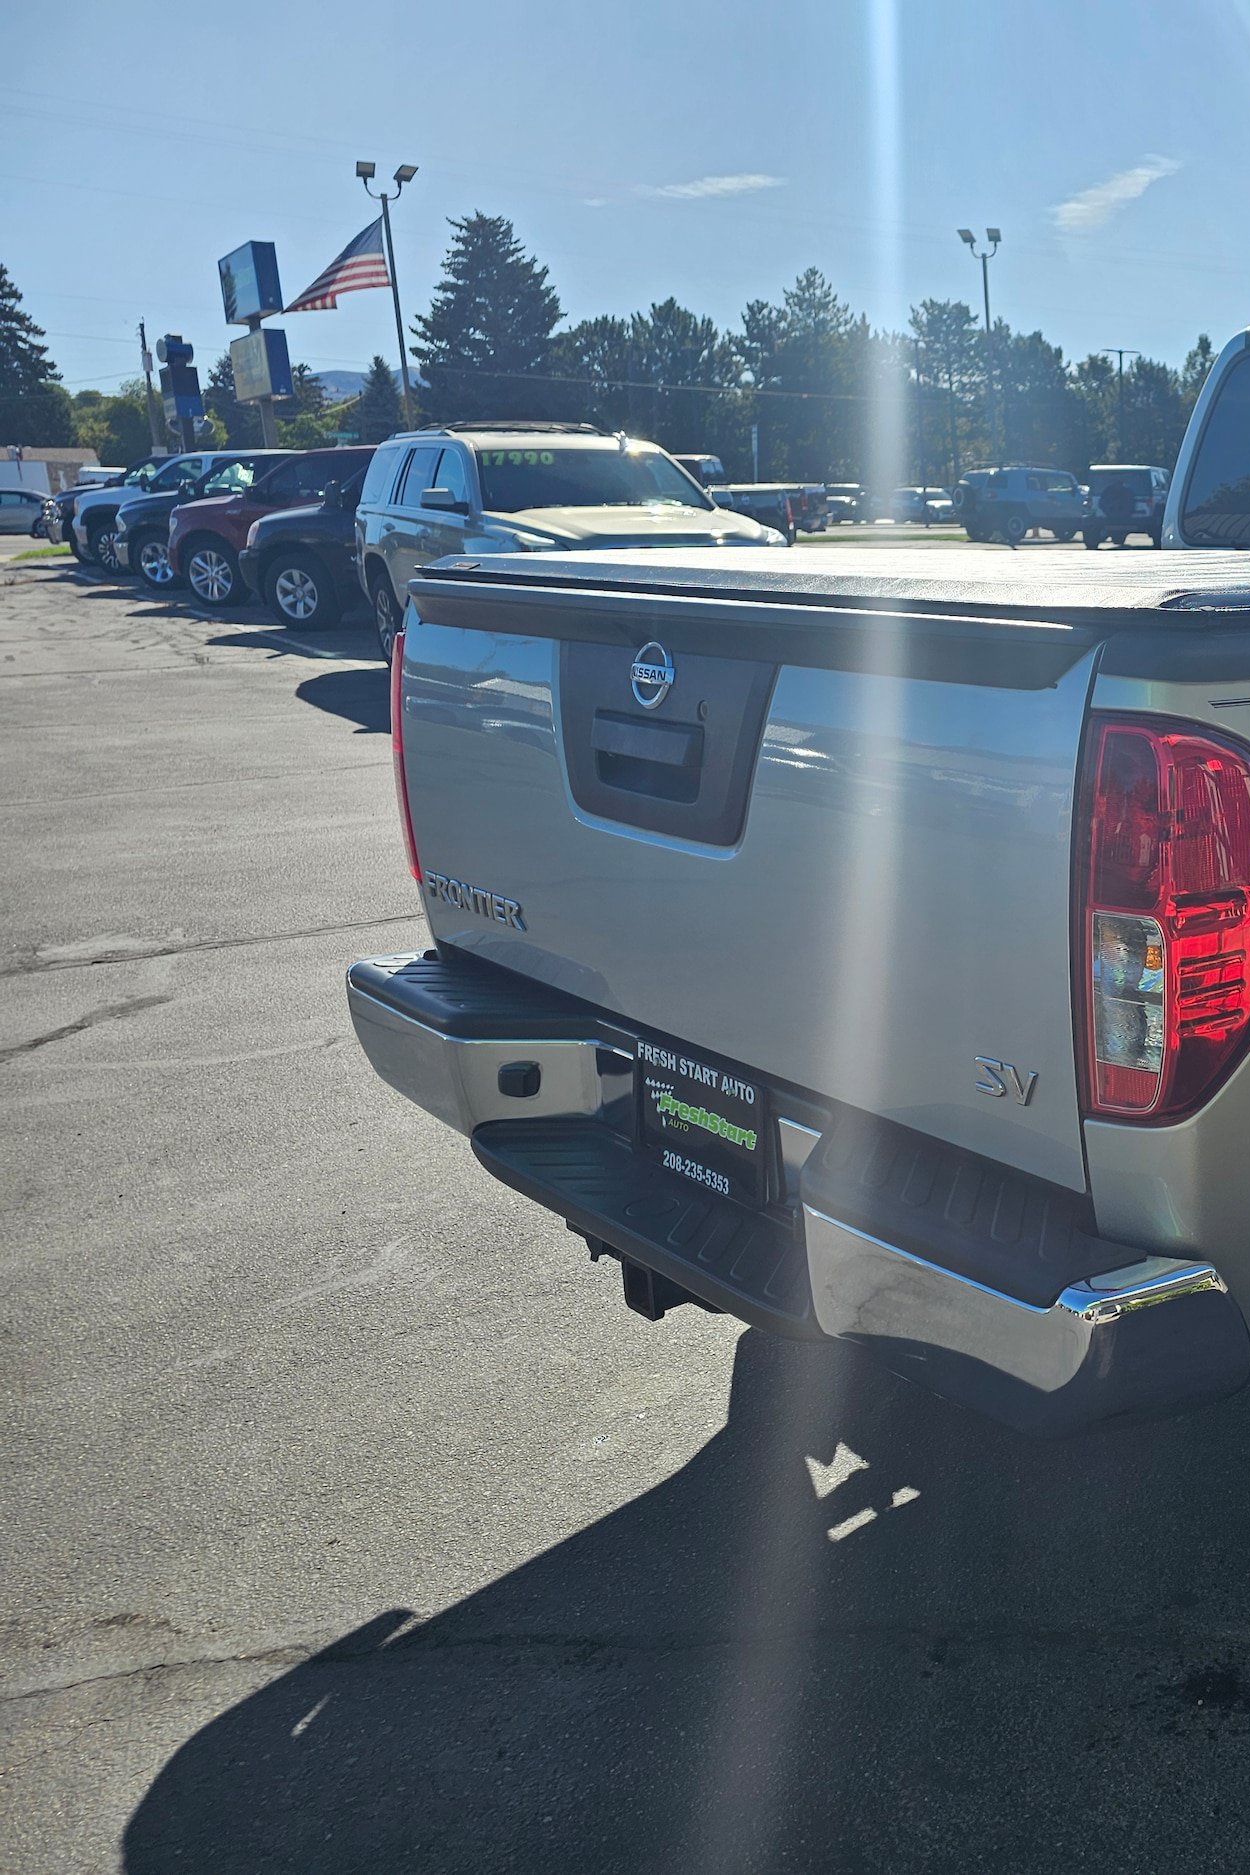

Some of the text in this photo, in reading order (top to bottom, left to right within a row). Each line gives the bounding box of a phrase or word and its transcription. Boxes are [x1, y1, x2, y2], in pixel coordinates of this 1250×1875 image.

[481, 451, 555, 466] 17990
[632, 666, 667, 681] NISSAN
[424, 869, 527, 932] FRONTIER
[638, 1041, 755, 1105] FRESH START AUTO
[974, 1055, 1039, 1107] SV
[668, 1118, 690, 1132] AUTO
[662, 1149, 730, 1195] 208-235-5353
